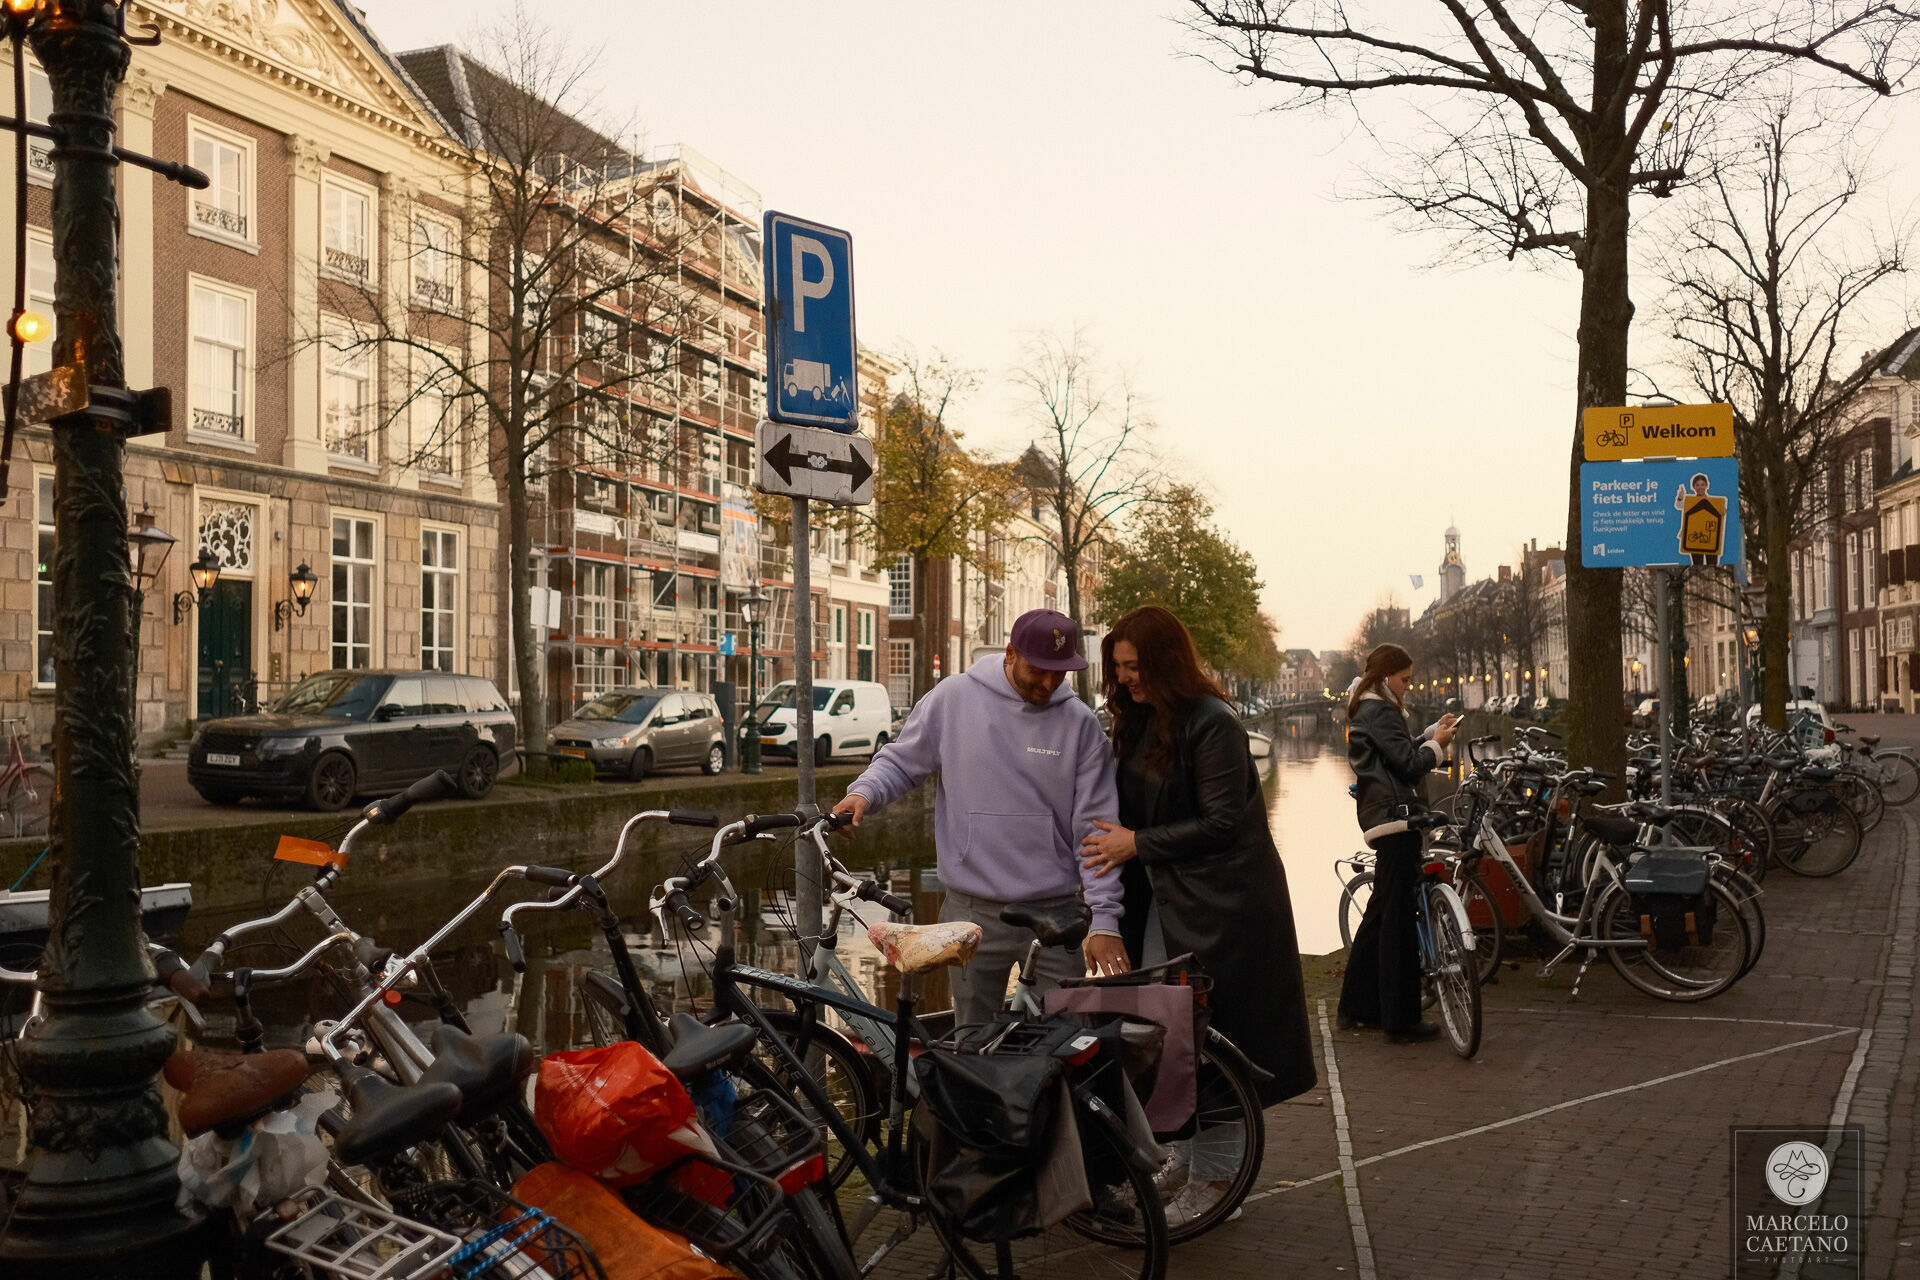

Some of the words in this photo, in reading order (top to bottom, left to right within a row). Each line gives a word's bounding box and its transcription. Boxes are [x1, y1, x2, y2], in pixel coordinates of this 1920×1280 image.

[791, 233, 835, 332] P
[1642, 423, 1716, 439] Welkom
[1592, 479, 1643, 491] Parkeer
[1646, 478, 1659, 492] je
[1592, 493, 1623, 504] fiets
[1626, 491, 1657, 503] hier!
[1592, 510, 1612, 518] Check
[1616, 517, 1645, 525] makkelijk
[741, 1013, 804, 1082] GAZELLE
